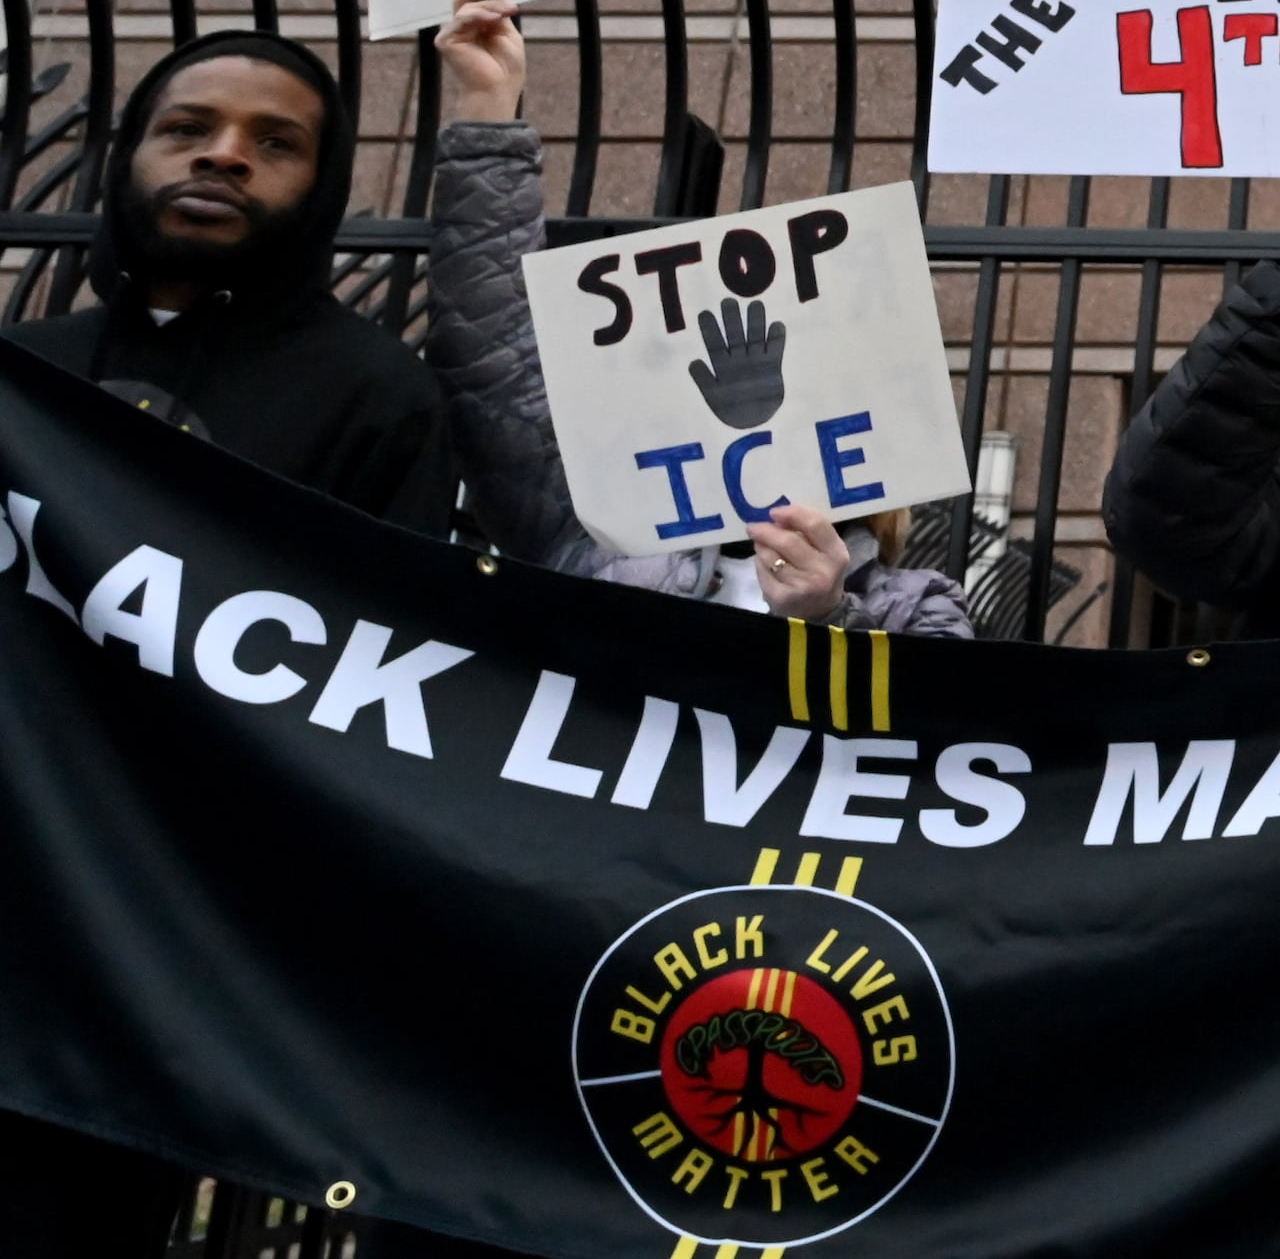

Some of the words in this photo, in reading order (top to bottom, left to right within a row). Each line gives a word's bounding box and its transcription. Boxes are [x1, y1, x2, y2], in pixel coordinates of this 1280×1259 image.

[577, 208, 850, 346] STOP
[634, 410, 885, 541] ICE
[0, 490, 476, 760] LACK
[500, 670, 1031, 847] LIVES
[610, 915, 764, 1044] BLACK
[806, 928, 917, 1066] LIVES
[632, 1111, 880, 1212] MATTER
